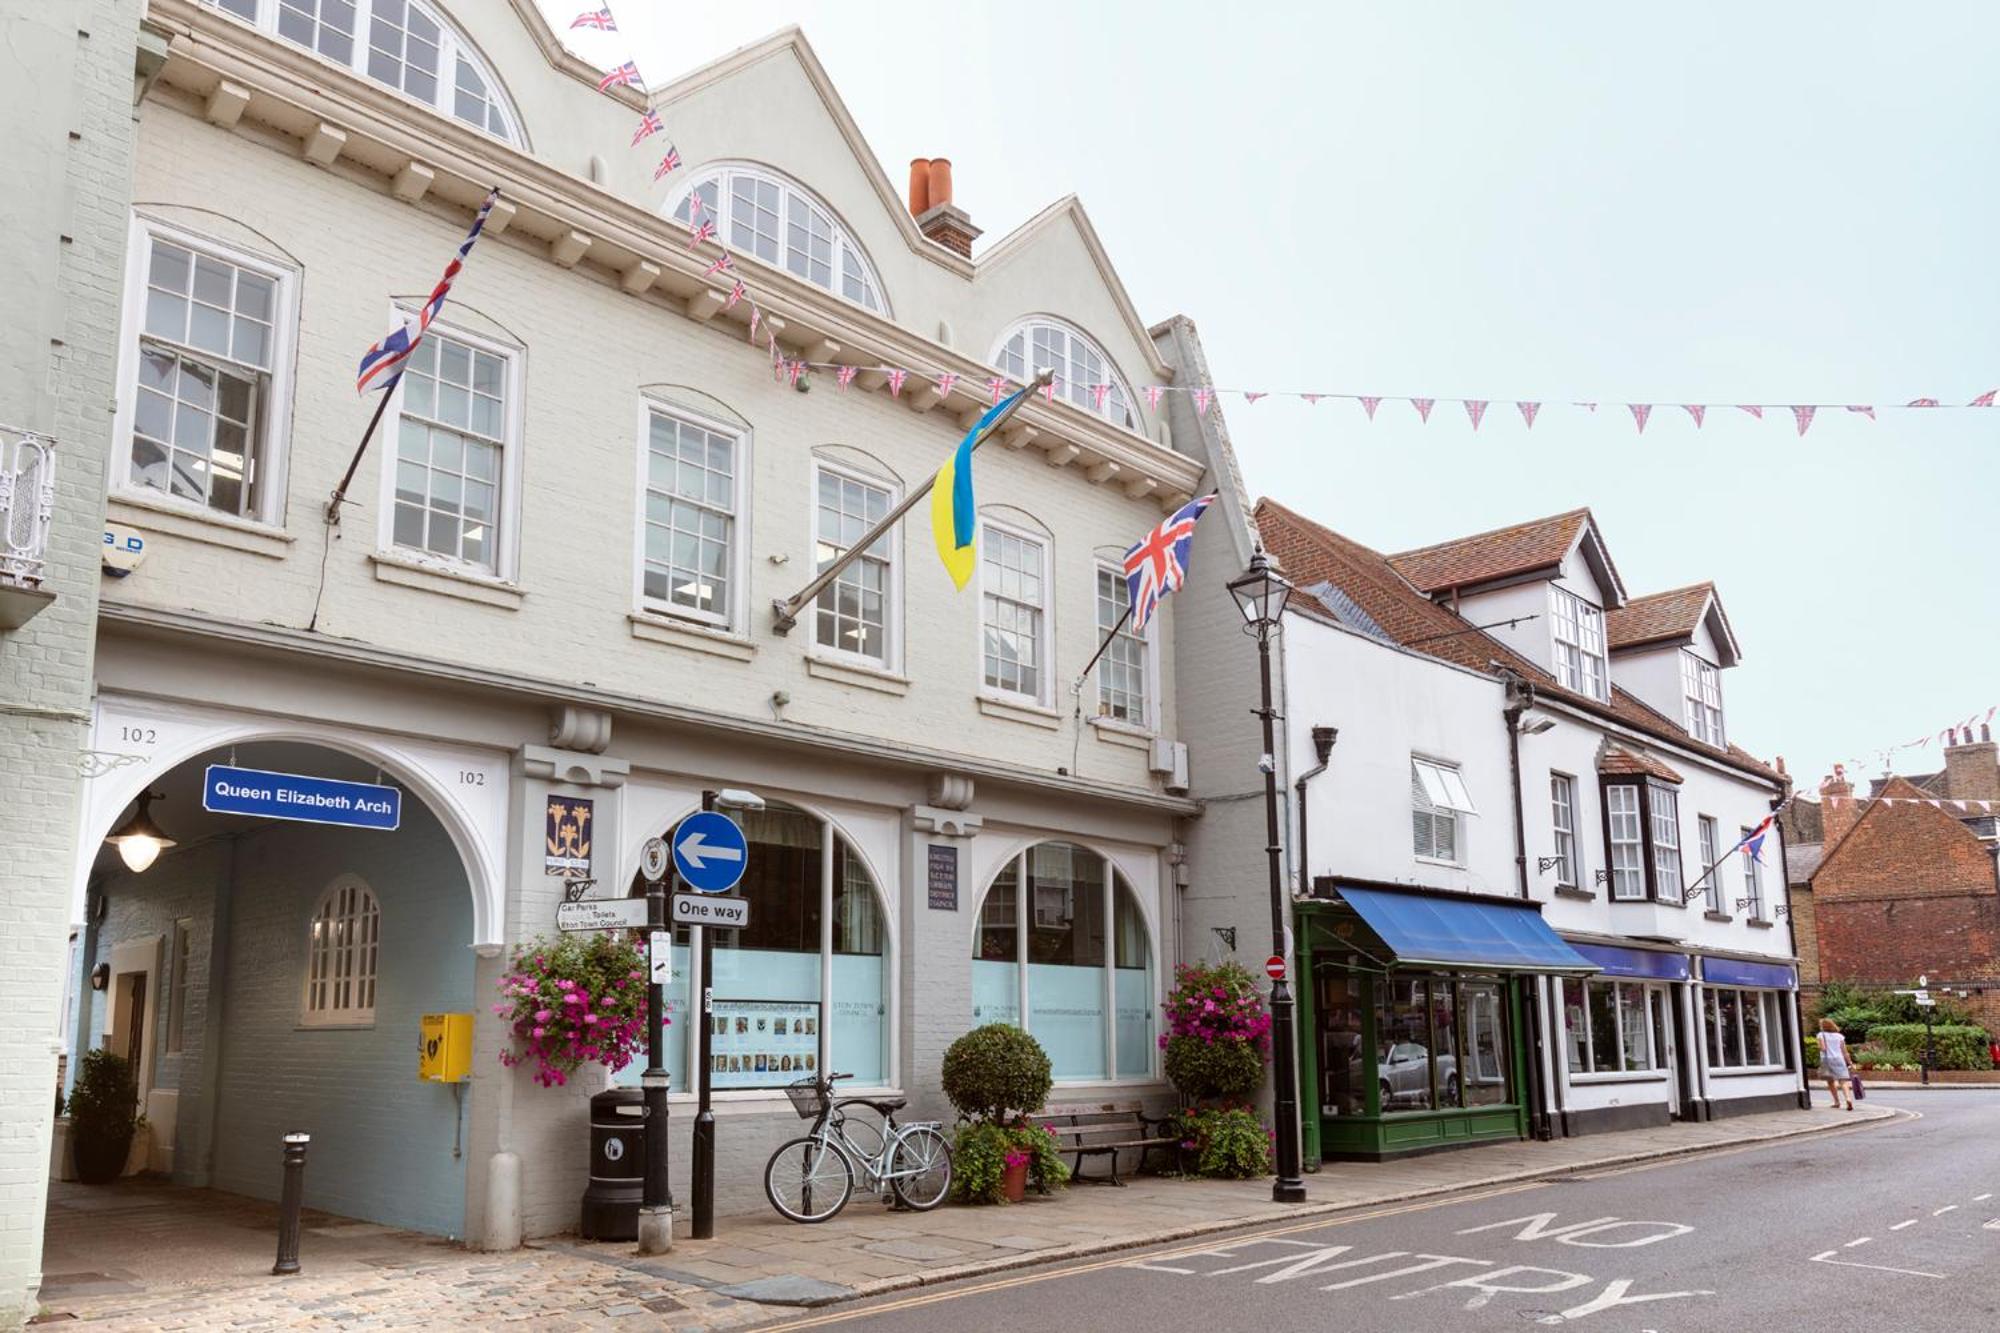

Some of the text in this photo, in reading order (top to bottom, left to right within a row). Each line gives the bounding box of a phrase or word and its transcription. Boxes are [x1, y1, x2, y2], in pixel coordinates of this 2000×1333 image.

[122, 726, 156, 744] 102
[459, 770, 484, 786] 102
[215, 781, 392, 815] Queen Elizabeth Arch
[576, 903, 598, 911] Parks
[679, 900, 743, 921] One way
[600, 918, 627, 927] Council
[1454, 1213, 1696, 1248] NO
[1122, 1237, 1716, 1325] ENTRY
